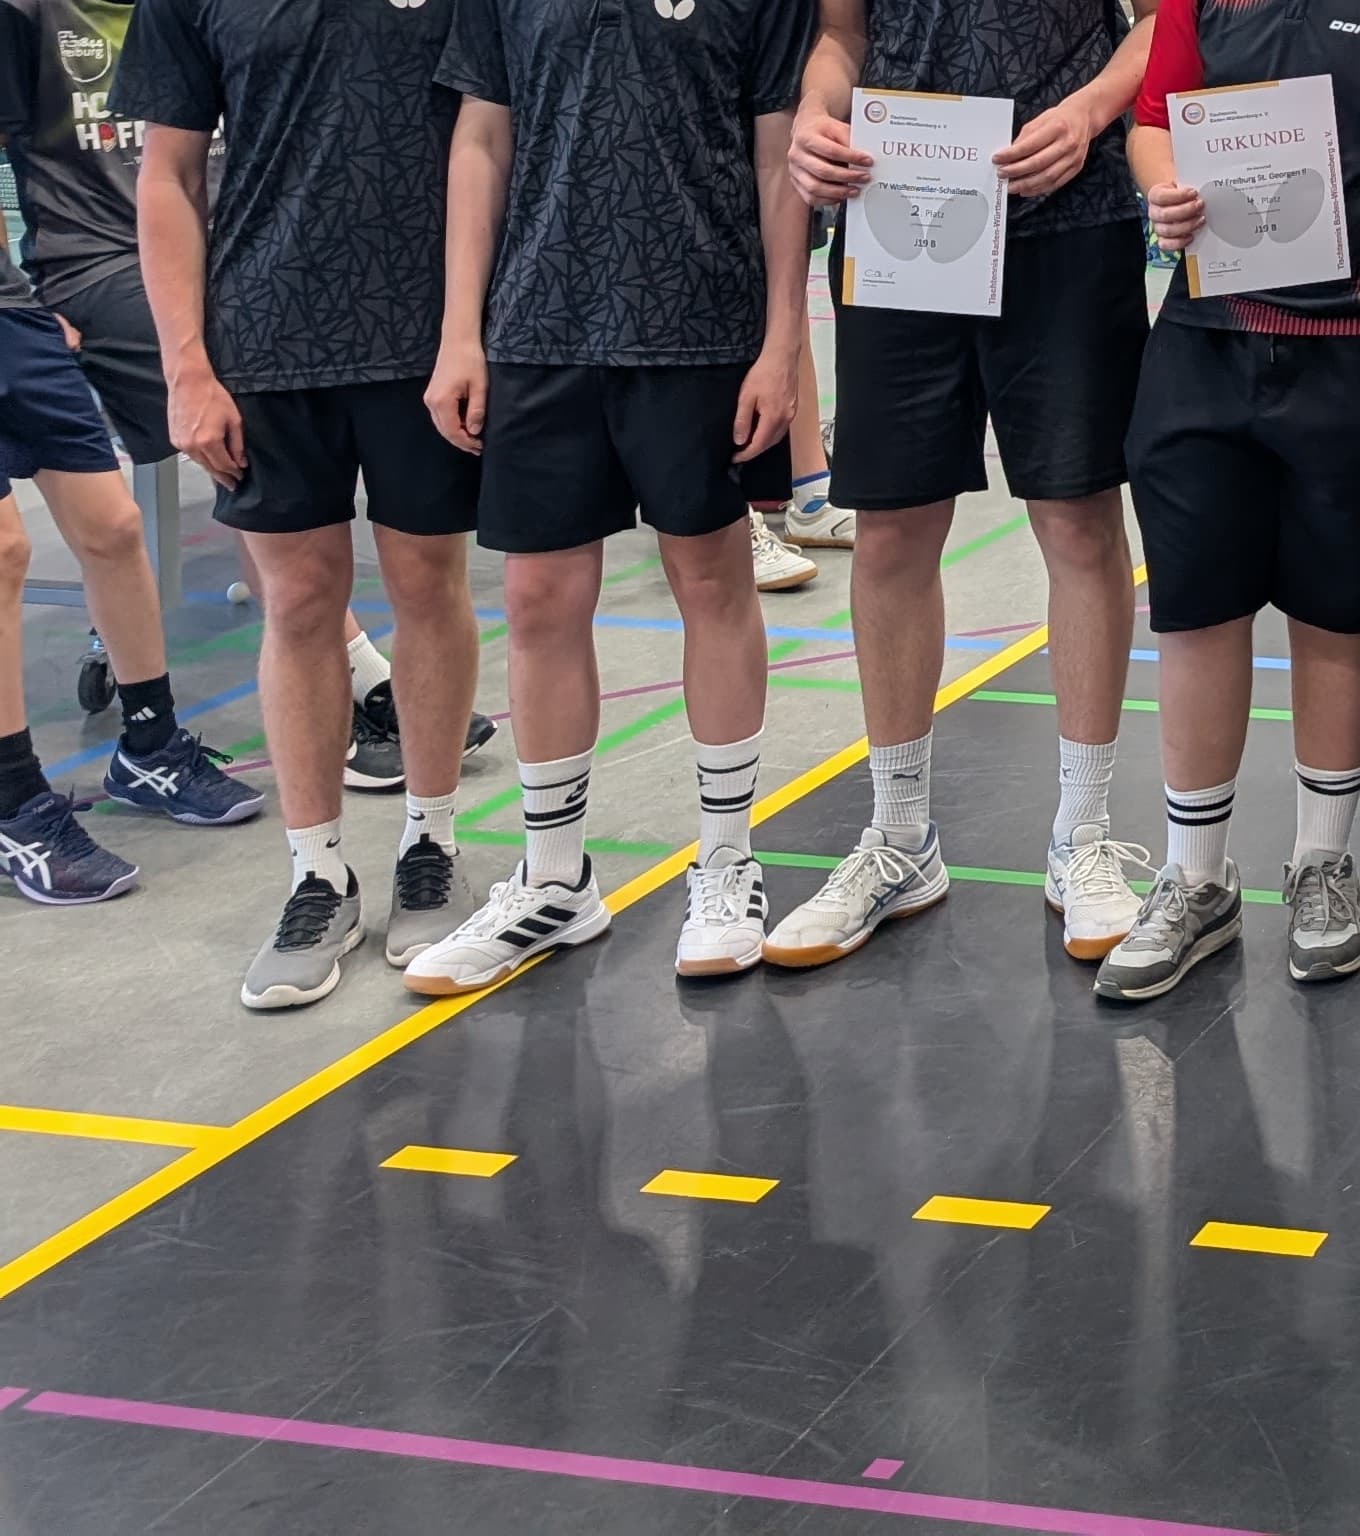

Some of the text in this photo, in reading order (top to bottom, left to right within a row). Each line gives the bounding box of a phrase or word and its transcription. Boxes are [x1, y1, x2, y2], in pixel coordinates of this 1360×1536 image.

[1206, 128, 1305, 154] URKUNDE
[882, 141, 979, 162] URKUNDE
[1225, 175, 1256, 185] Freiburg
[1269, 169, 1301, 180] Georgen
[878, 181, 889, 190] TV
[925, 209, 945, 219] Platz
[914, 238, 928, 248] J19
